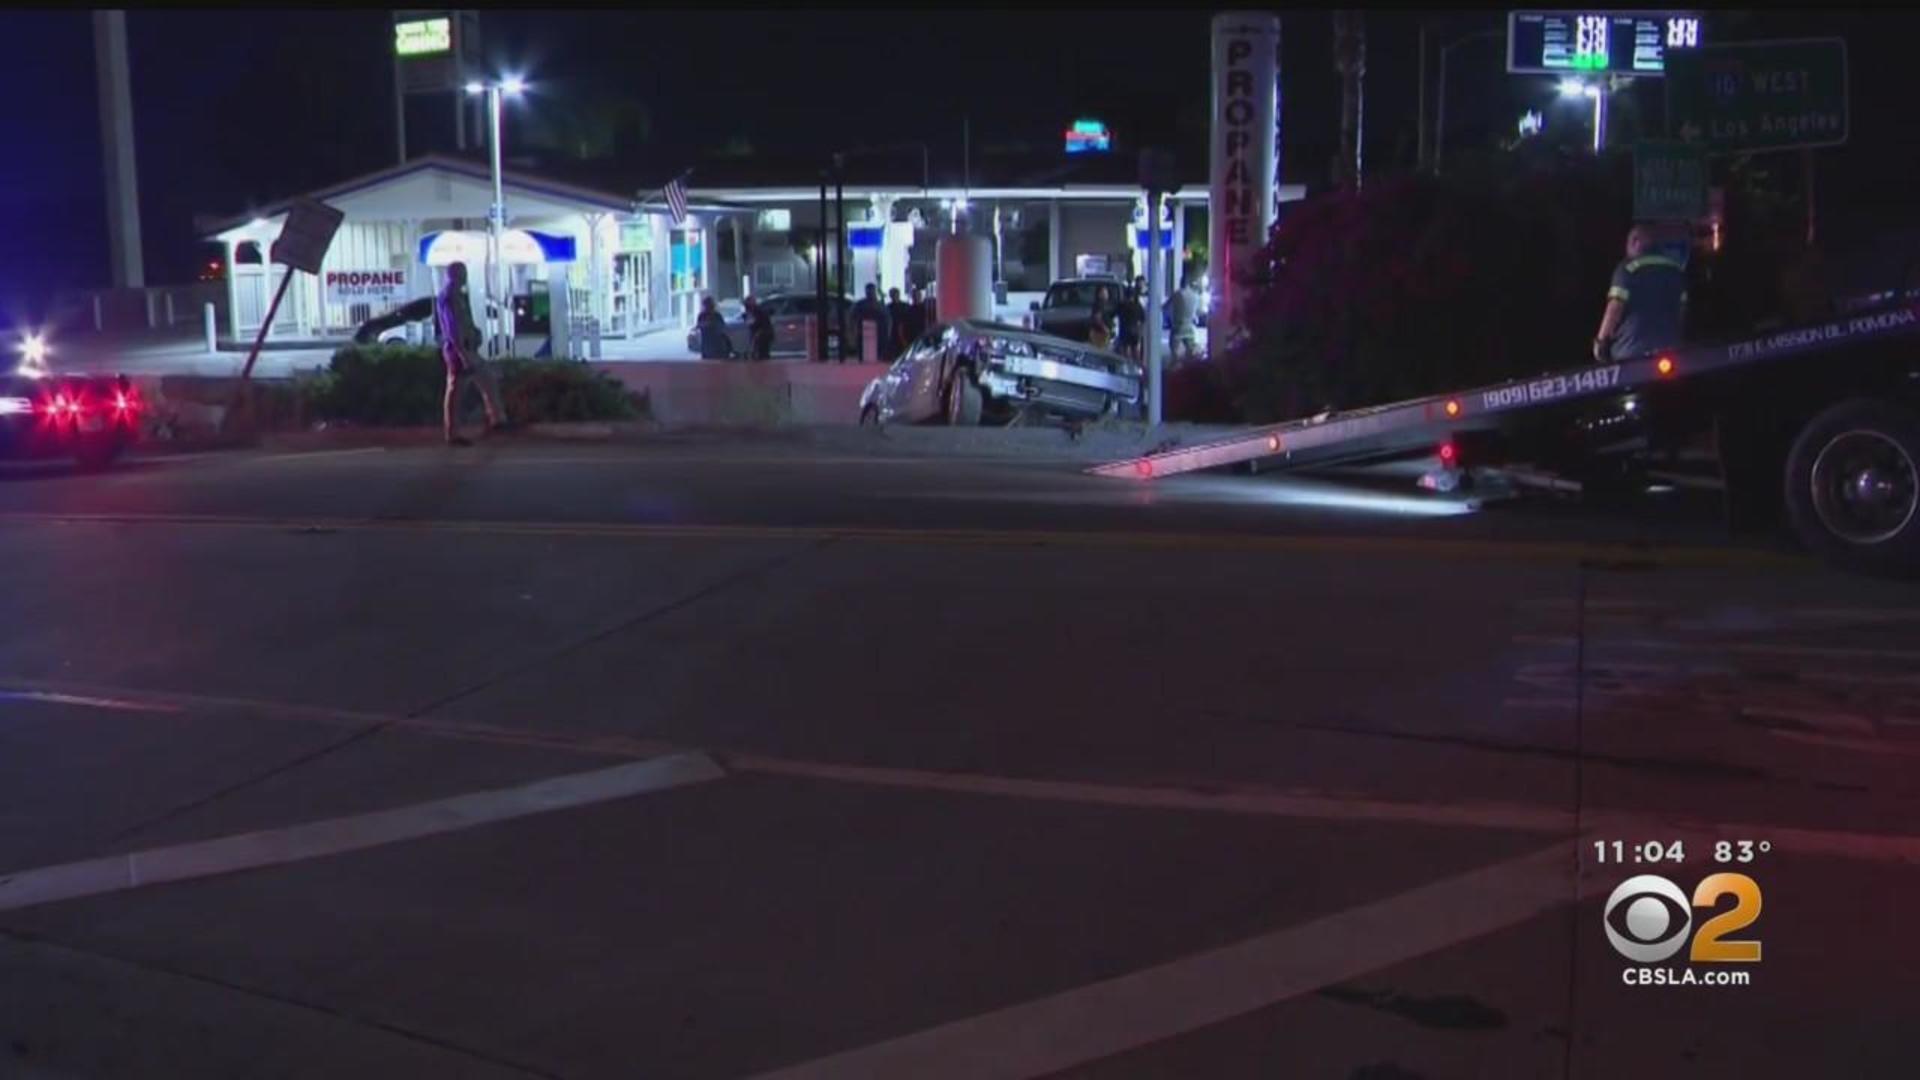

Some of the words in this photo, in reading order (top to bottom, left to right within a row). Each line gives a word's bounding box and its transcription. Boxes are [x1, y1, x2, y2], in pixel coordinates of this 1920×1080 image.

[1751, 69, 1809, 94] WEST
[1712, 119, 1750, 138] Los
[1761, 112, 1840, 138] Angeles
[1225, 41, 1254, 244] PROPANE
[326, 271, 404, 286] PROPANE
[1849, 308, 1916, 335] POMONA
